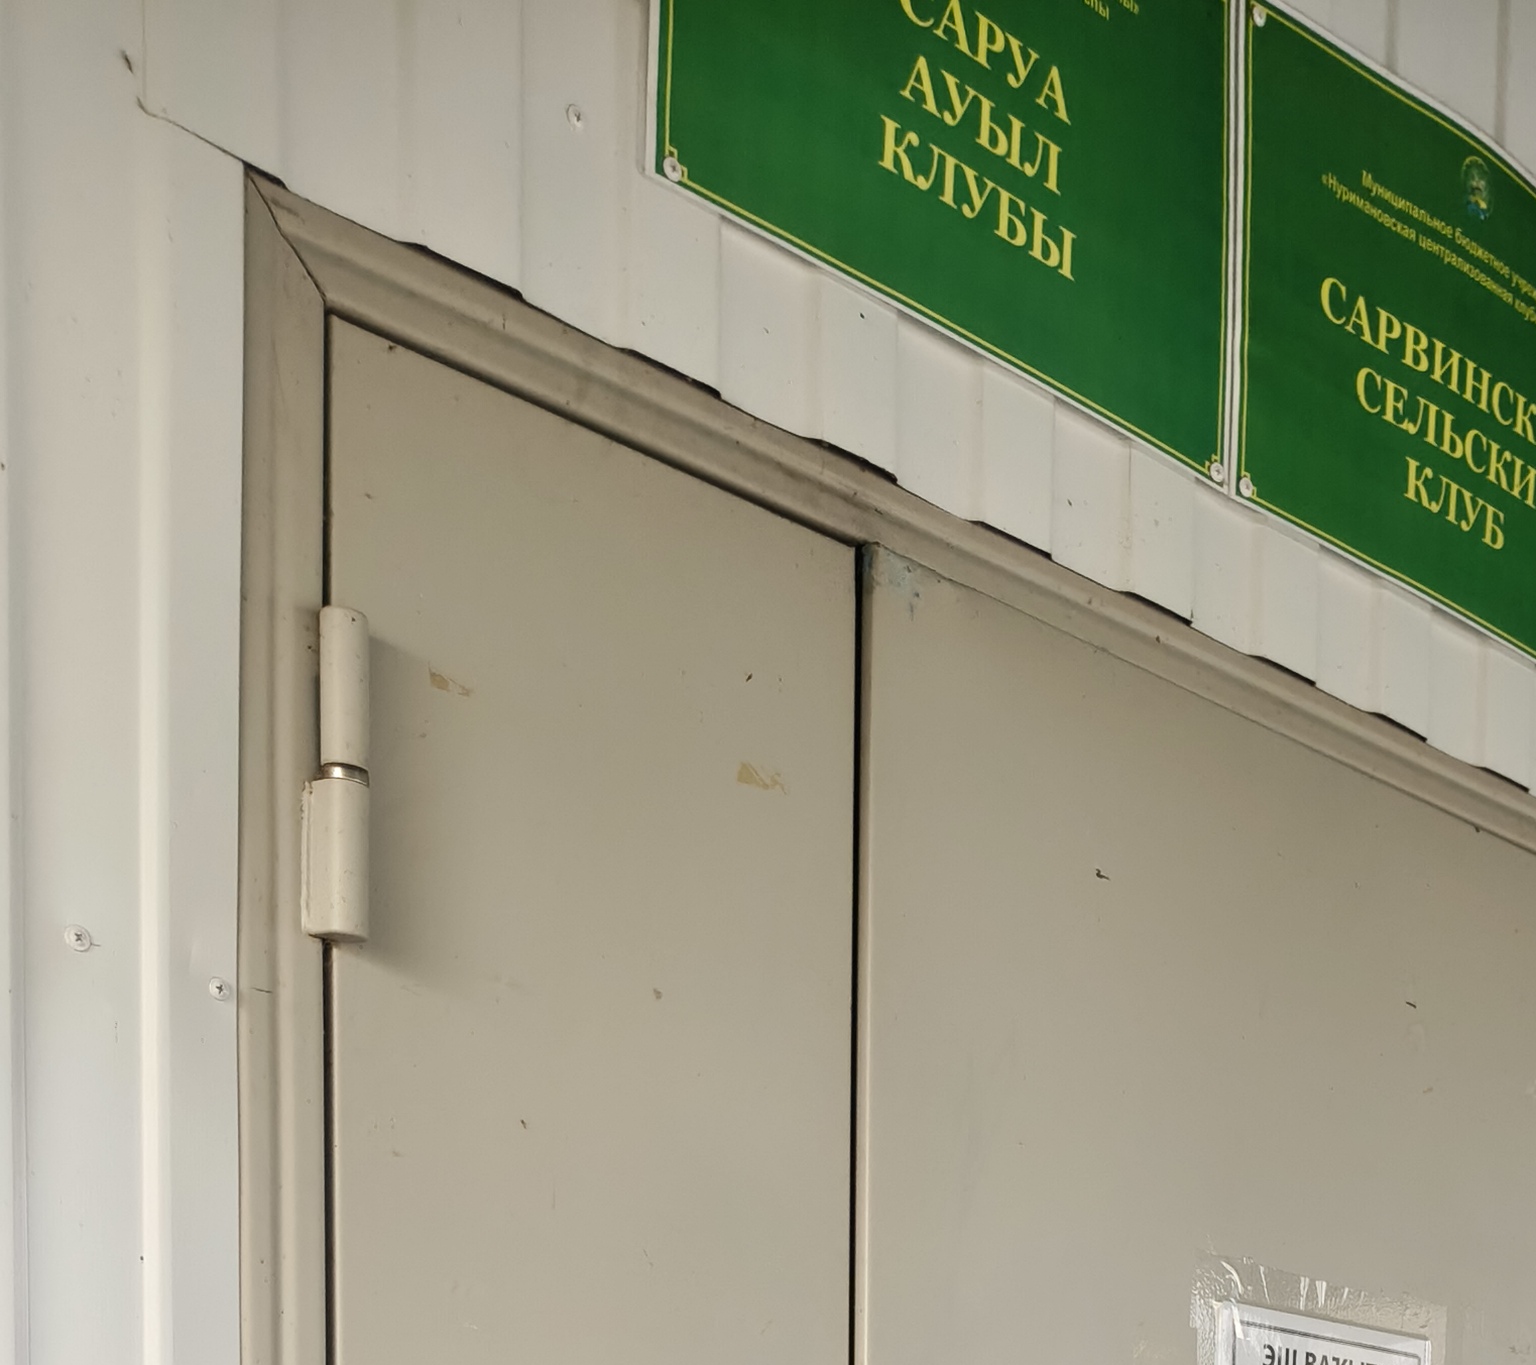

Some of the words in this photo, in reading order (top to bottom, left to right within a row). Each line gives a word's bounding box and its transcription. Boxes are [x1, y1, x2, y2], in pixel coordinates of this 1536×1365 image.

[899, 55, 1063, 196] АУЫЛ
[878, 114, 1077, 282] КЛУБЫ
[1362, 170, 1453, 239] Муниципальное
[1455, 228, 1510, 278] бюджетное
[1404, 456, 1505, 550] КЛУБ
